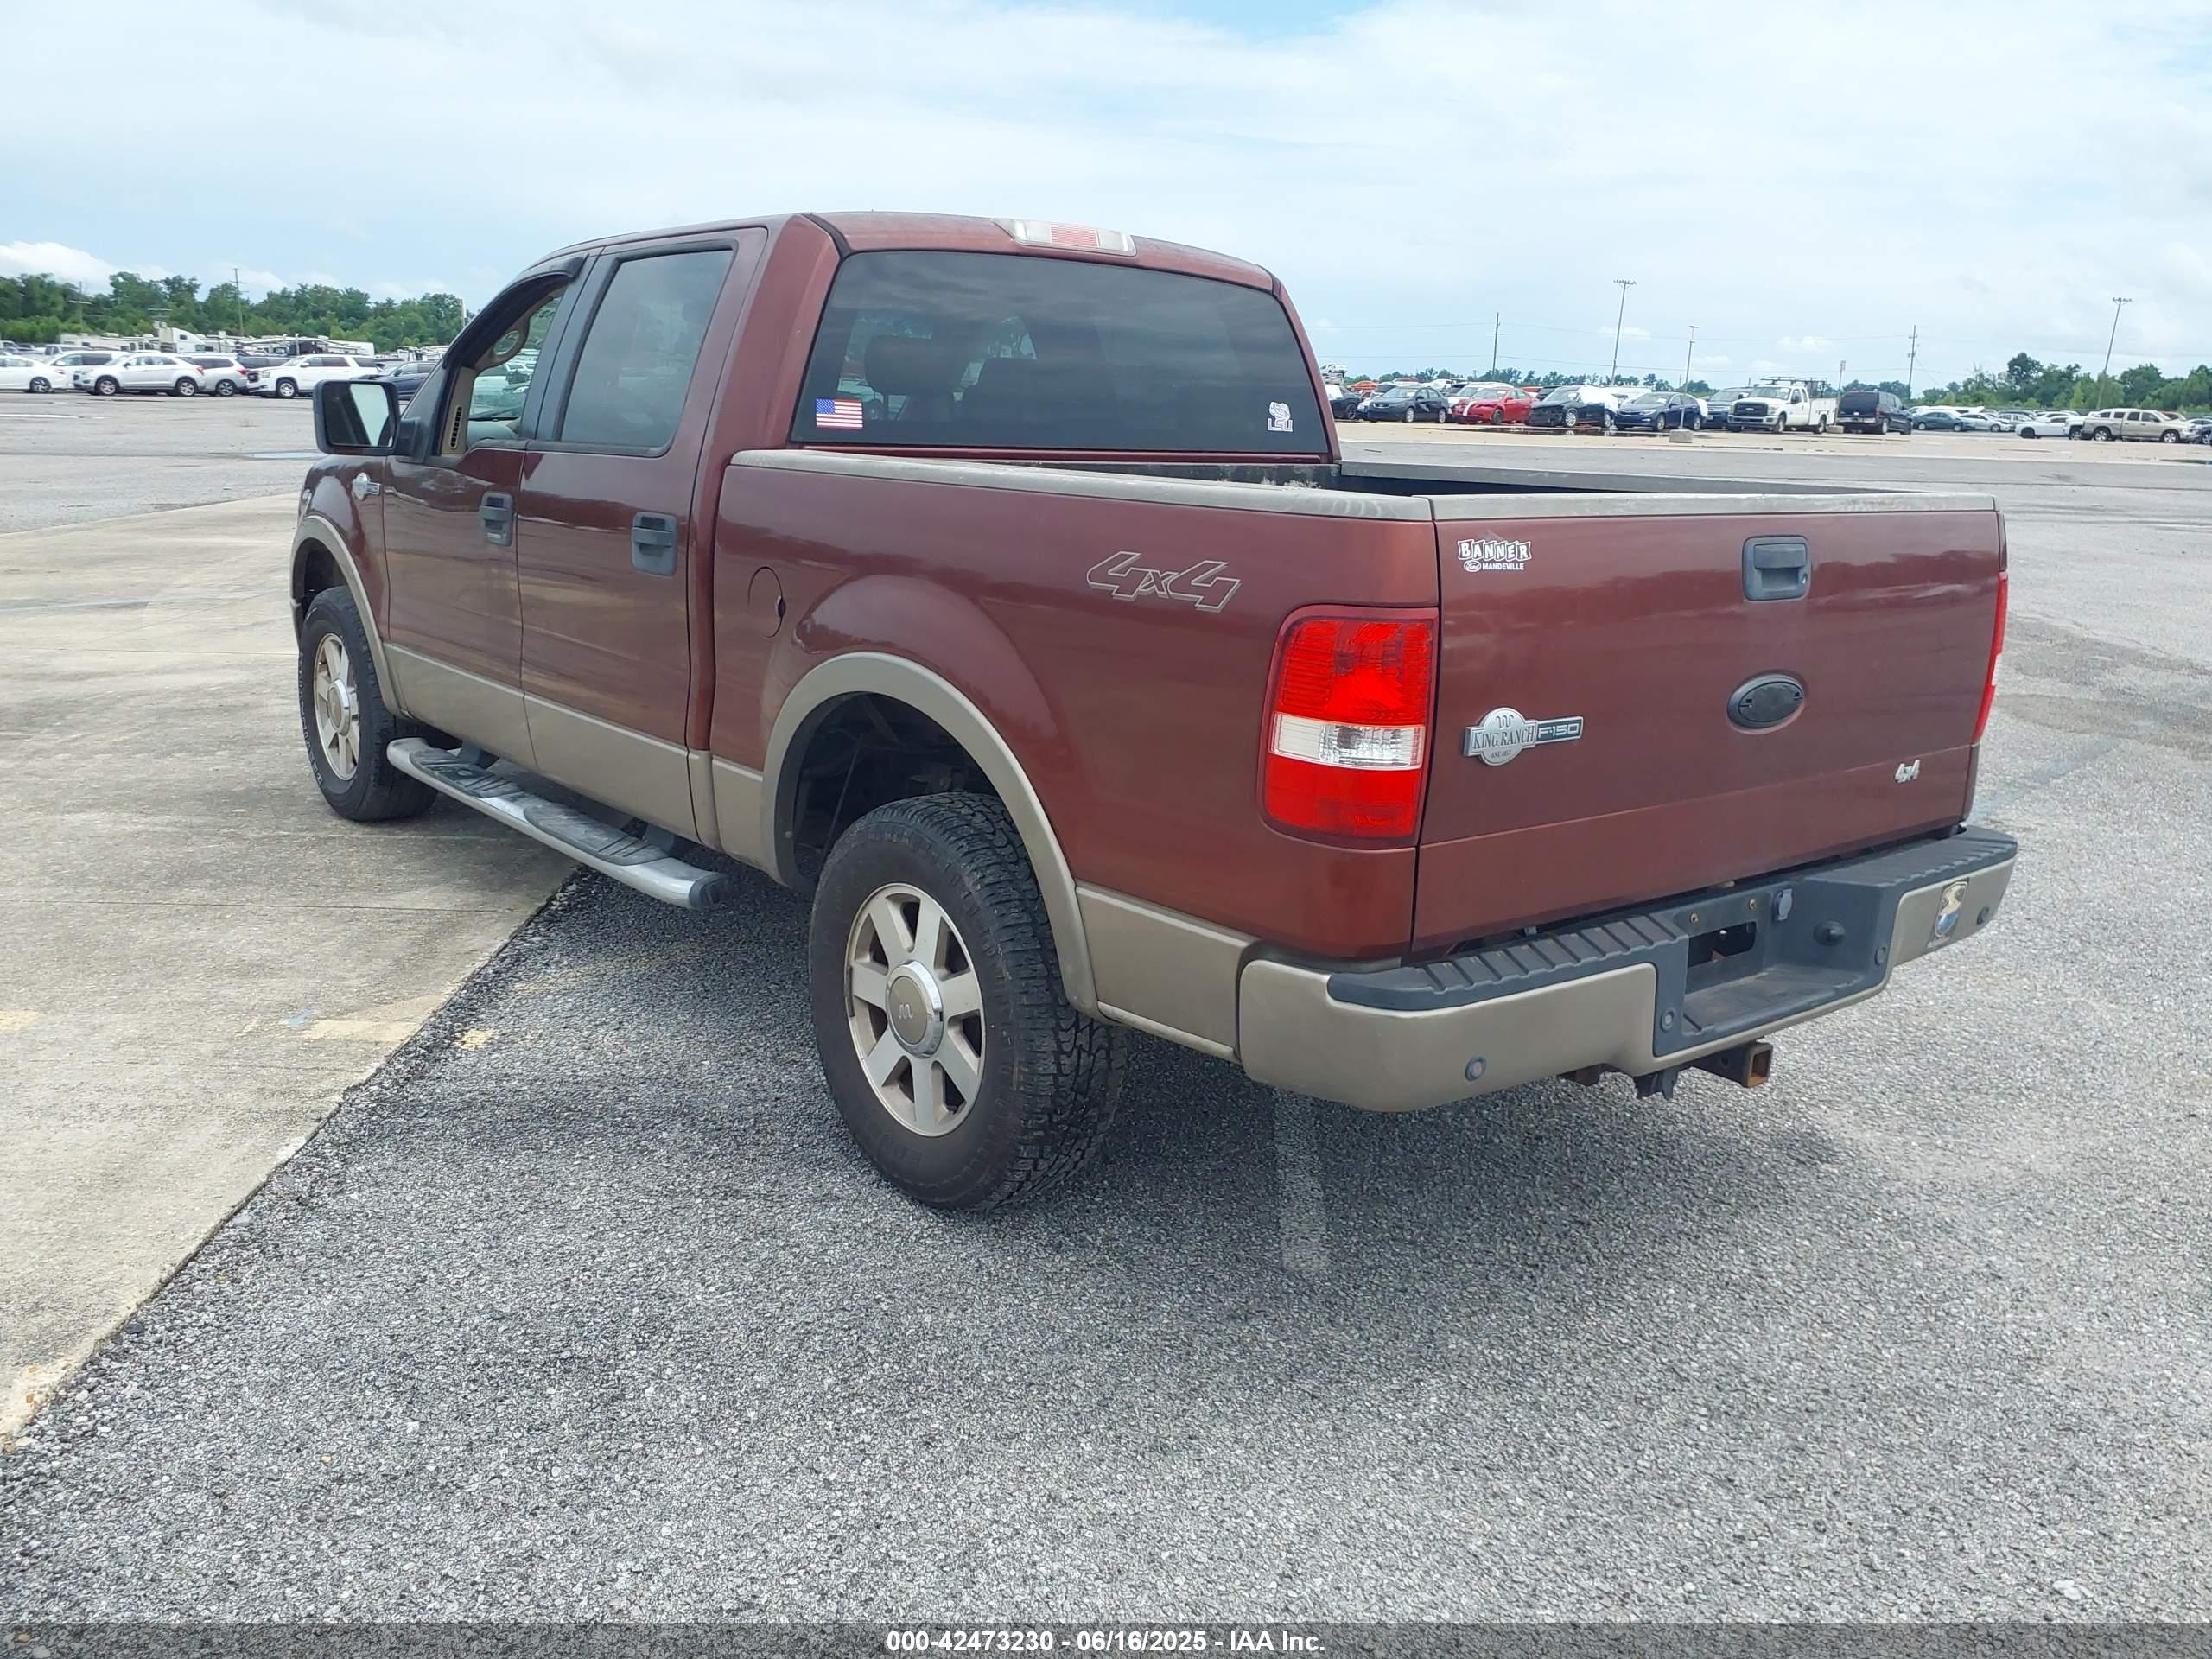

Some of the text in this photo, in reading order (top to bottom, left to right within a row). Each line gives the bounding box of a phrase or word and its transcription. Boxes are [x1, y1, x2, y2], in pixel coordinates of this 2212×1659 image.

[1267, 417, 1294, 433] LSU
[1459, 541, 1529, 561] BANNER
[1086, 550, 1242, 613] 4x4
[1473, 725, 1535, 749] KING RANCH
